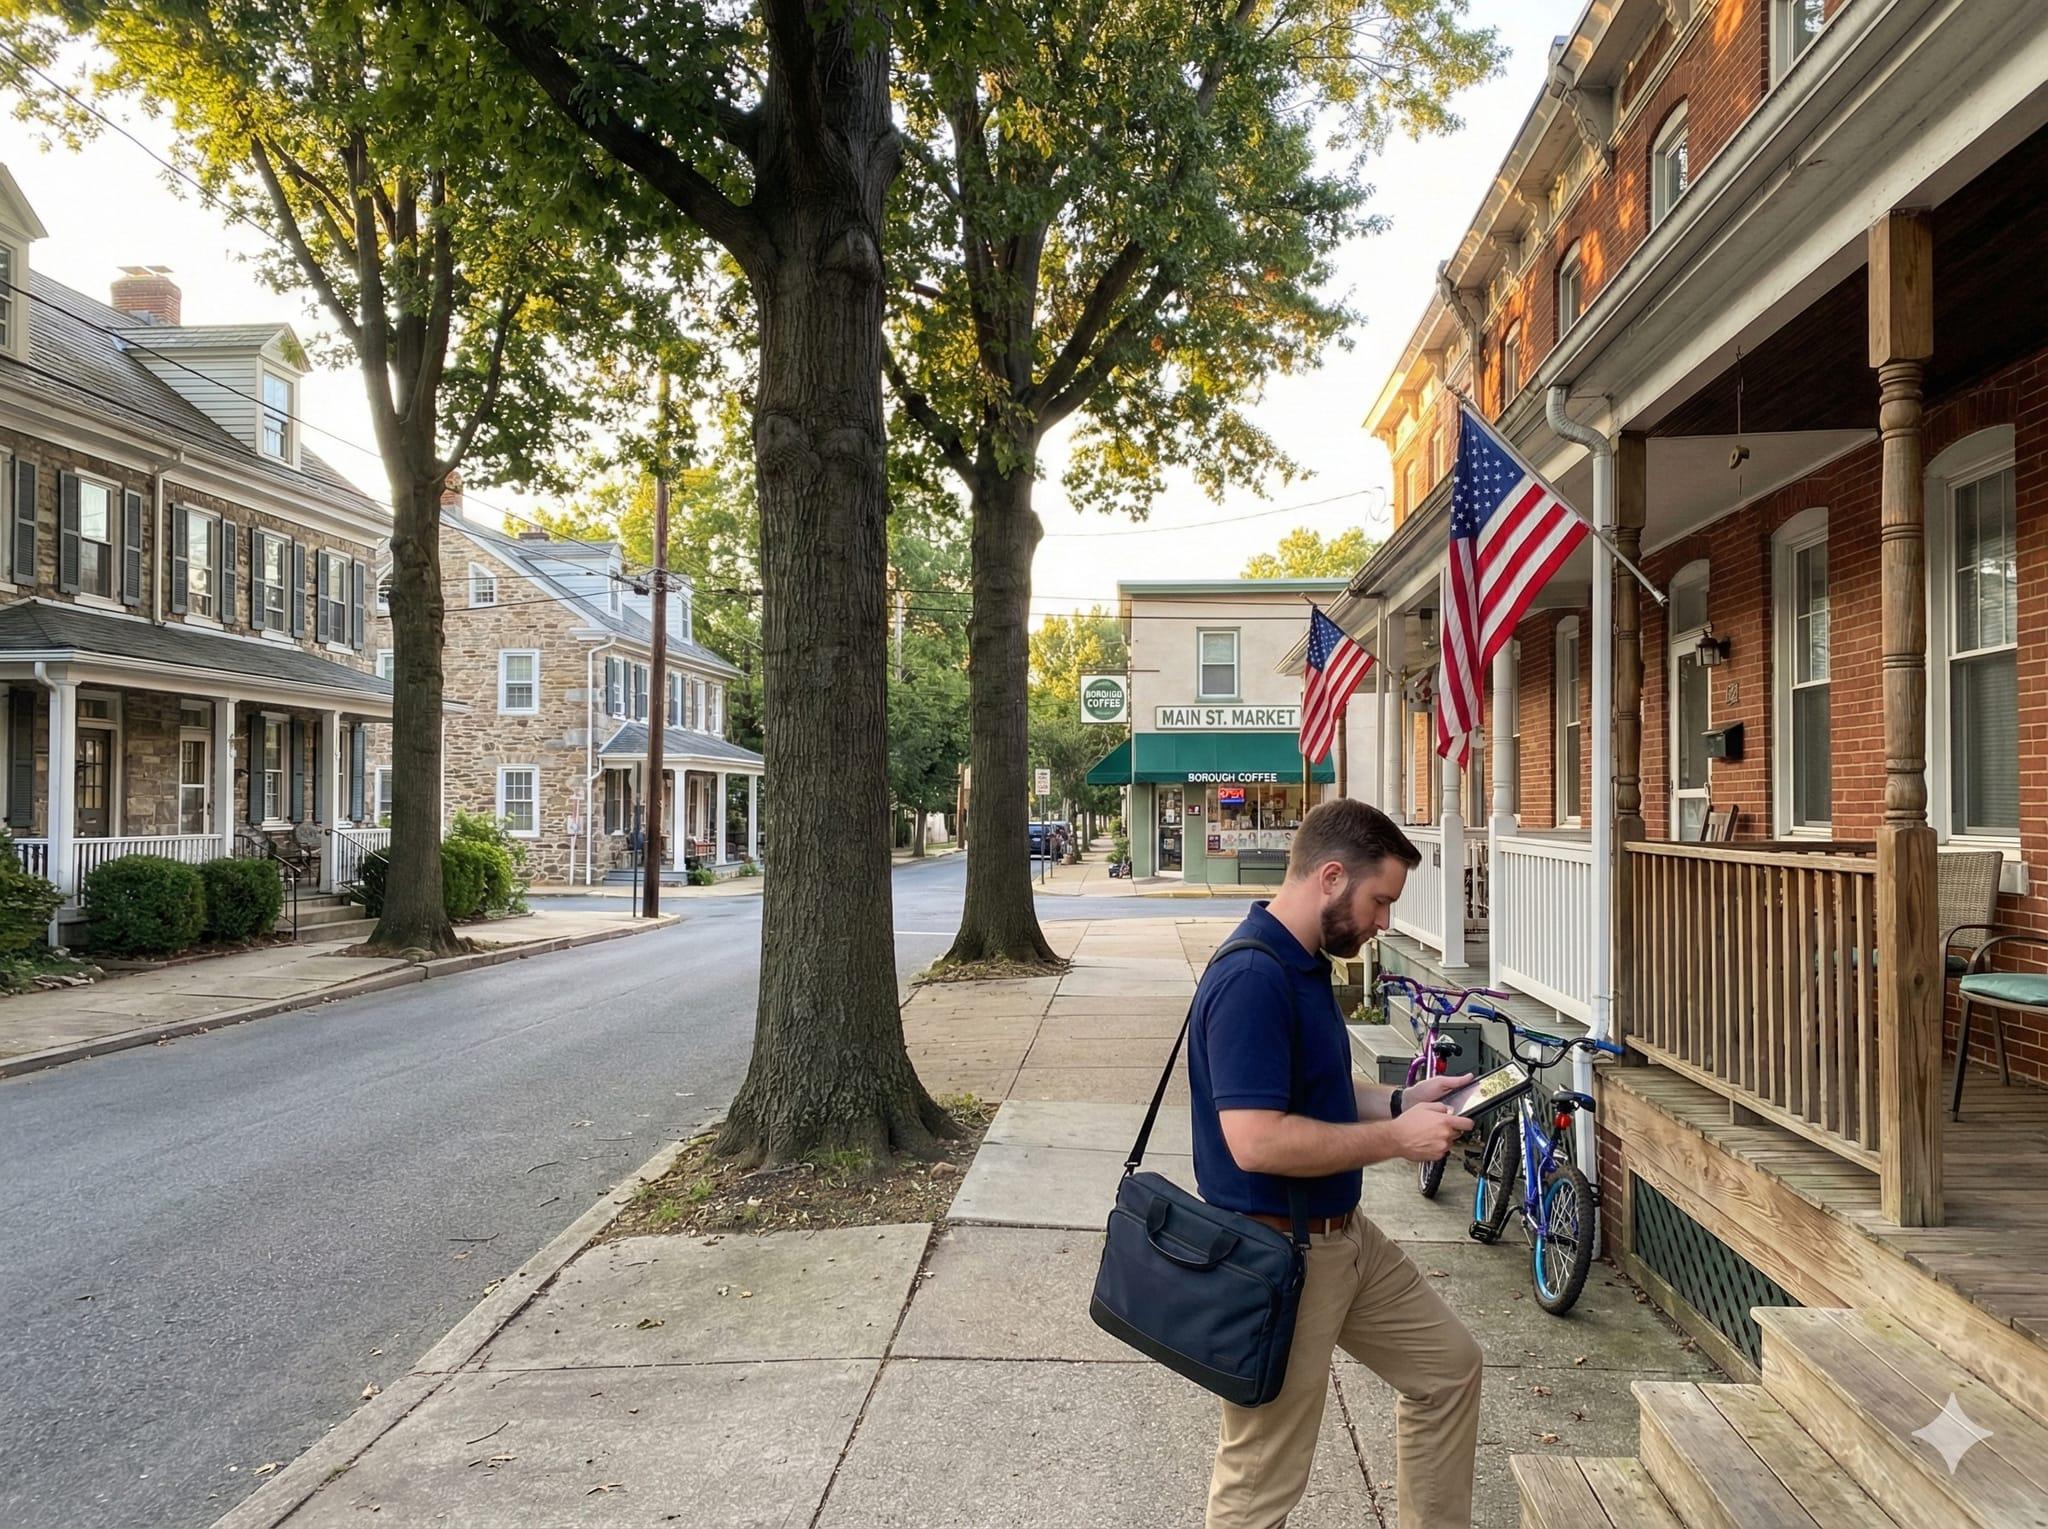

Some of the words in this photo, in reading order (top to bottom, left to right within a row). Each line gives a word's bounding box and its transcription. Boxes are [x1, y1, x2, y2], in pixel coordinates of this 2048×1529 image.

[1087, 699, 1121, 708] COFFEE
[1162, 709, 1201, 726] MAIN
[1205, 709, 1228, 726] ST.
[1232, 709, 1296, 726] MARKET
[1188, 772, 1236, 783] BOROUGH
[1238, 772, 1278, 783] COFFEE
